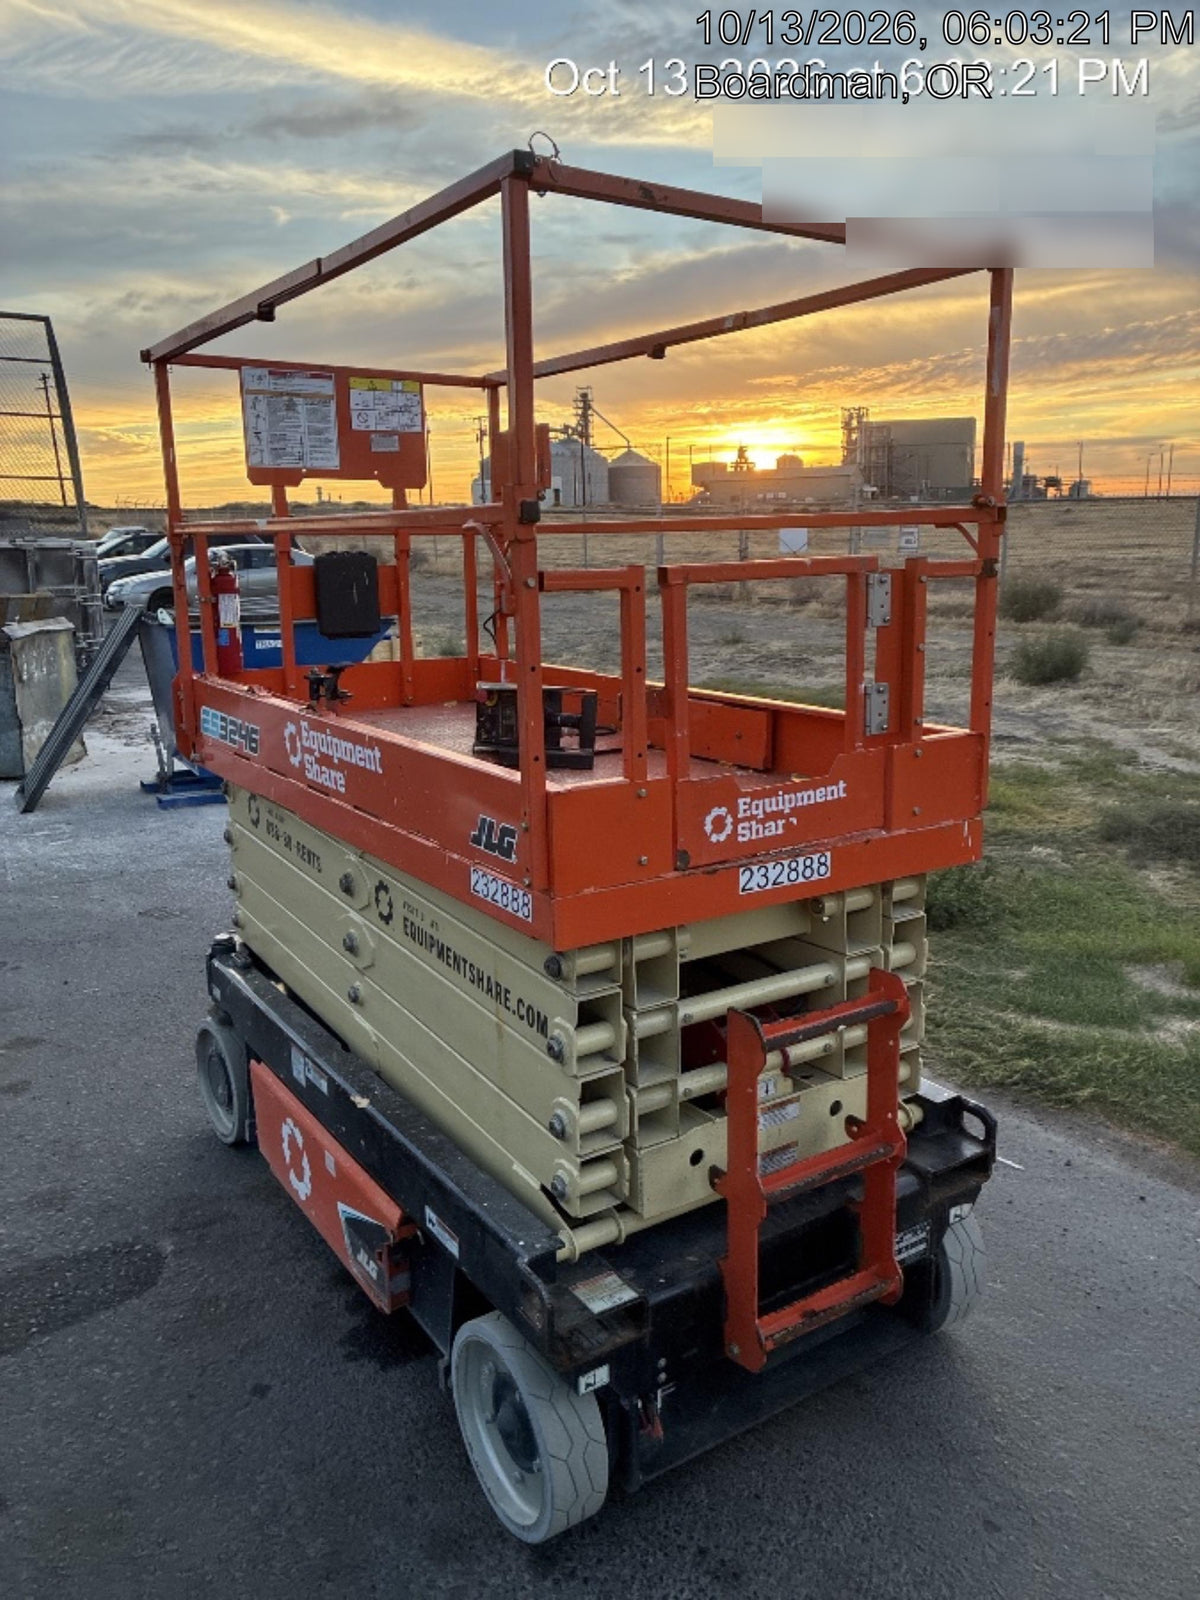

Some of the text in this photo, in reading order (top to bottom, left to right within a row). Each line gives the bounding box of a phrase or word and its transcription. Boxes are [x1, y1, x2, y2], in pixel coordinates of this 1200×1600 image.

[200, 706, 260, 756] ES3246
[301, 720, 383, 774] Equipment
[303, 754, 346, 794] Share
[737, 780, 847, 819] Equipment
[469, 814, 518, 864] JLG
[472, 868, 530, 918] 232888
[741, 854, 829, 892] 232888
[403, 916, 549, 1038] EQUIPMENTSHARE.COM
